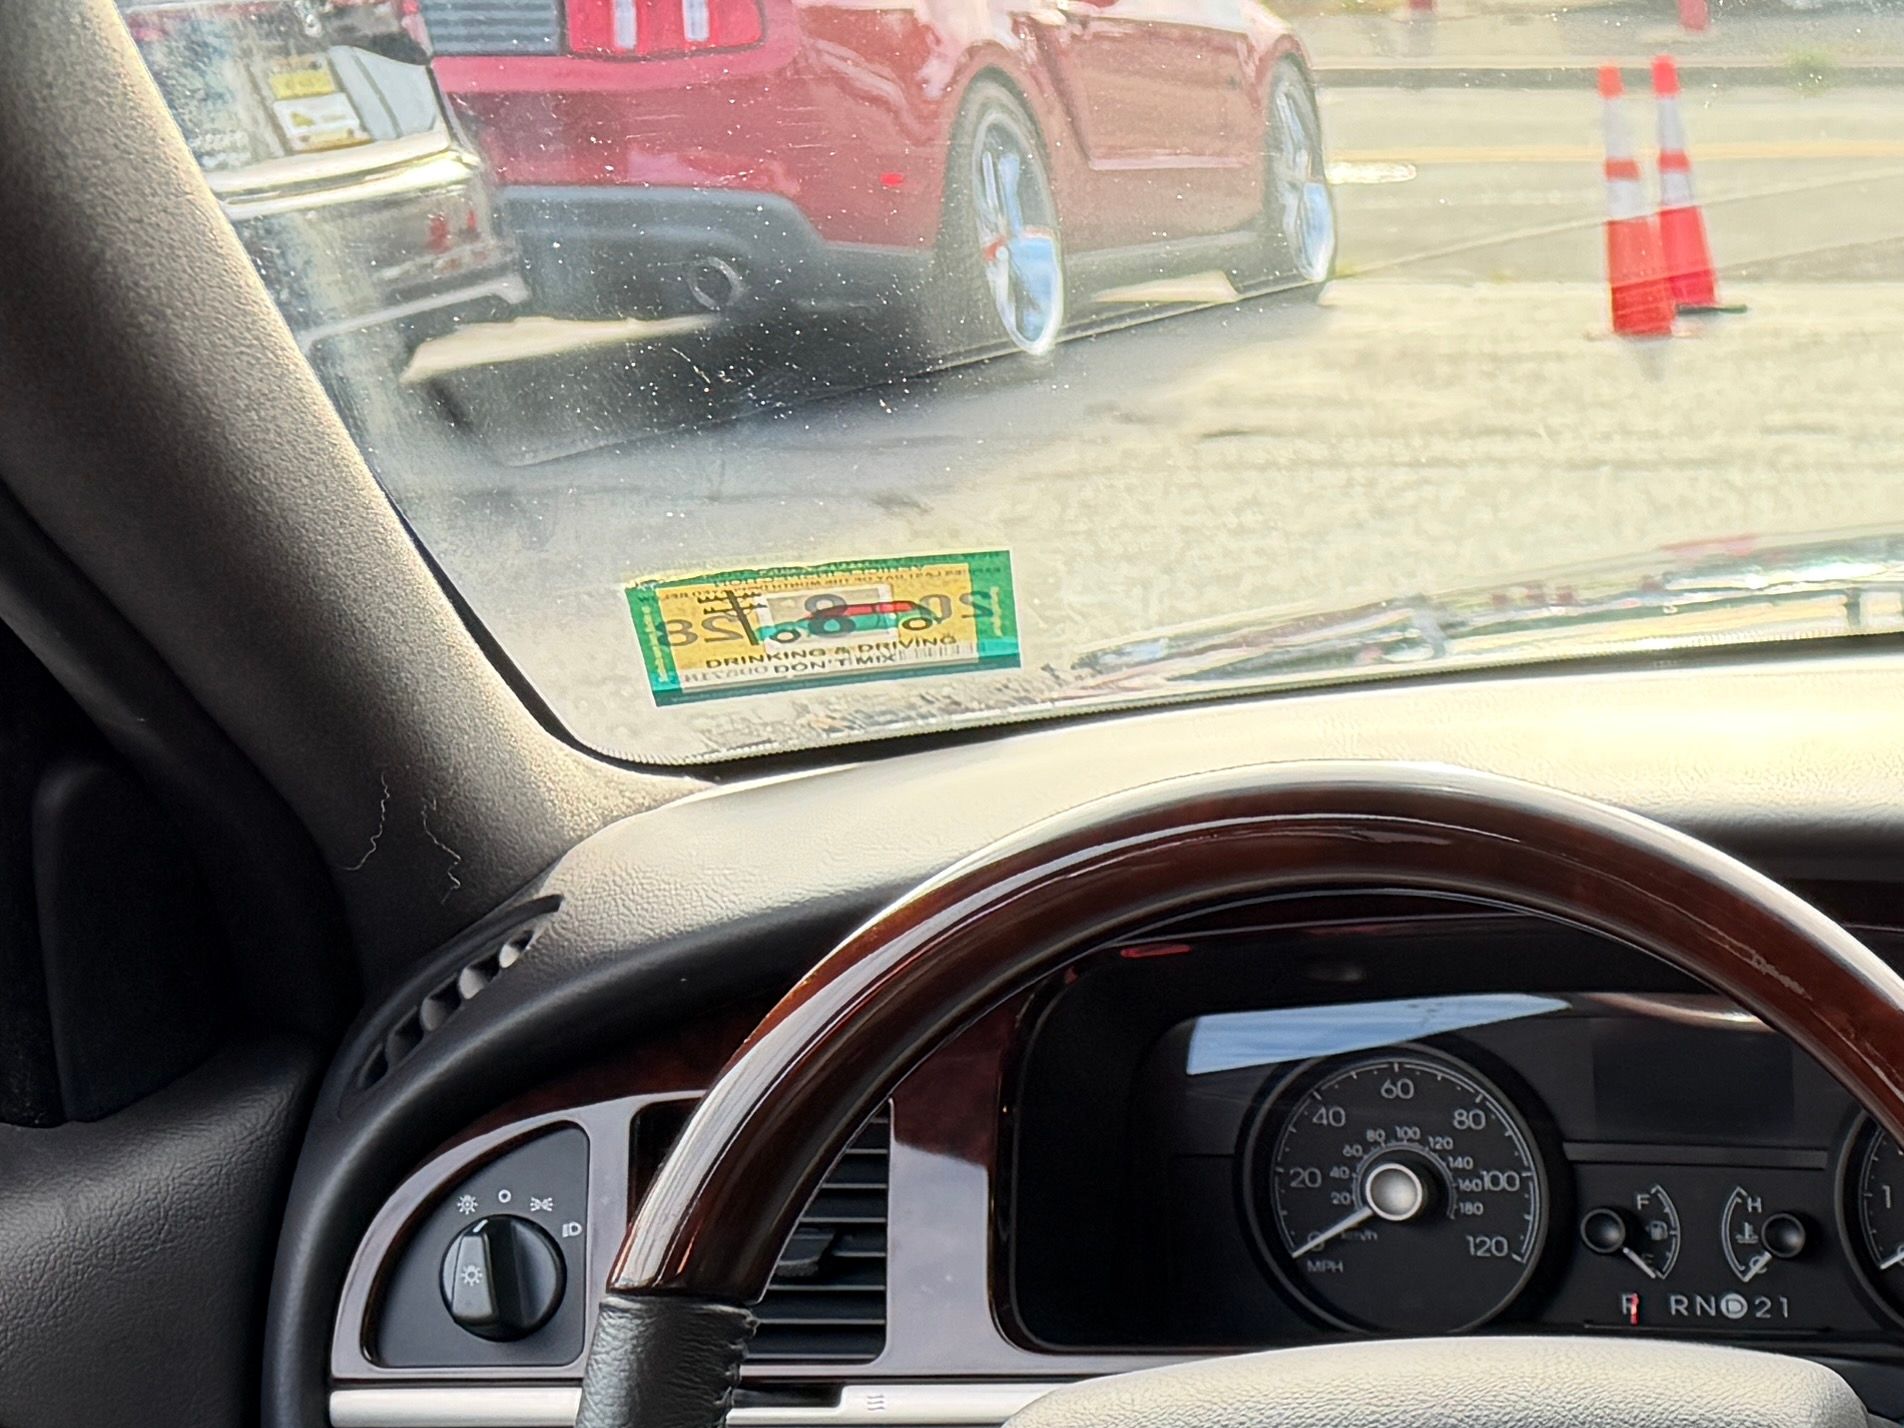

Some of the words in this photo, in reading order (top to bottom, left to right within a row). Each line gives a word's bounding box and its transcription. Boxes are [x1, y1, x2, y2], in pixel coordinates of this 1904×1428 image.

[706, 648, 827, 669] DRINKING
[857, 634, 958, 653] DRIVING
[773, 657, 849, 674] DON'T
[855, 653, 897, 665] MIX
[1380, 1078, 1414, 1099] 60
[1312, 1107, 1346, 1127] 40
[1453, 1109, 1486, 1130] 80
[1366, 1129, 1385, 1142] 80
[1395, 1127, 1420, 1139] 100
[1428, 1136, 1453, 1149] 120
[1343, 1145, 1363, 1157] 60
[1447, 1156, 1473, 1170] 140
[1290, 1167, 1322, 1188] 20
[1330, 1166, 1349, 1178] 40
[1458, 1179, 1482, 1192] 160
[1481, 1170, 1520, 1191] 100
[1330, 1192, 1350, 1205] 20
[1636, 1194, 1650, 1210] F
[1747, 1197, 1762, 1213] H
[1459, 1202, 1483, 1215] 180
[1466, 1236, 1508, 1257] 120
[1307, 1259, 1344, 1273] MPH
